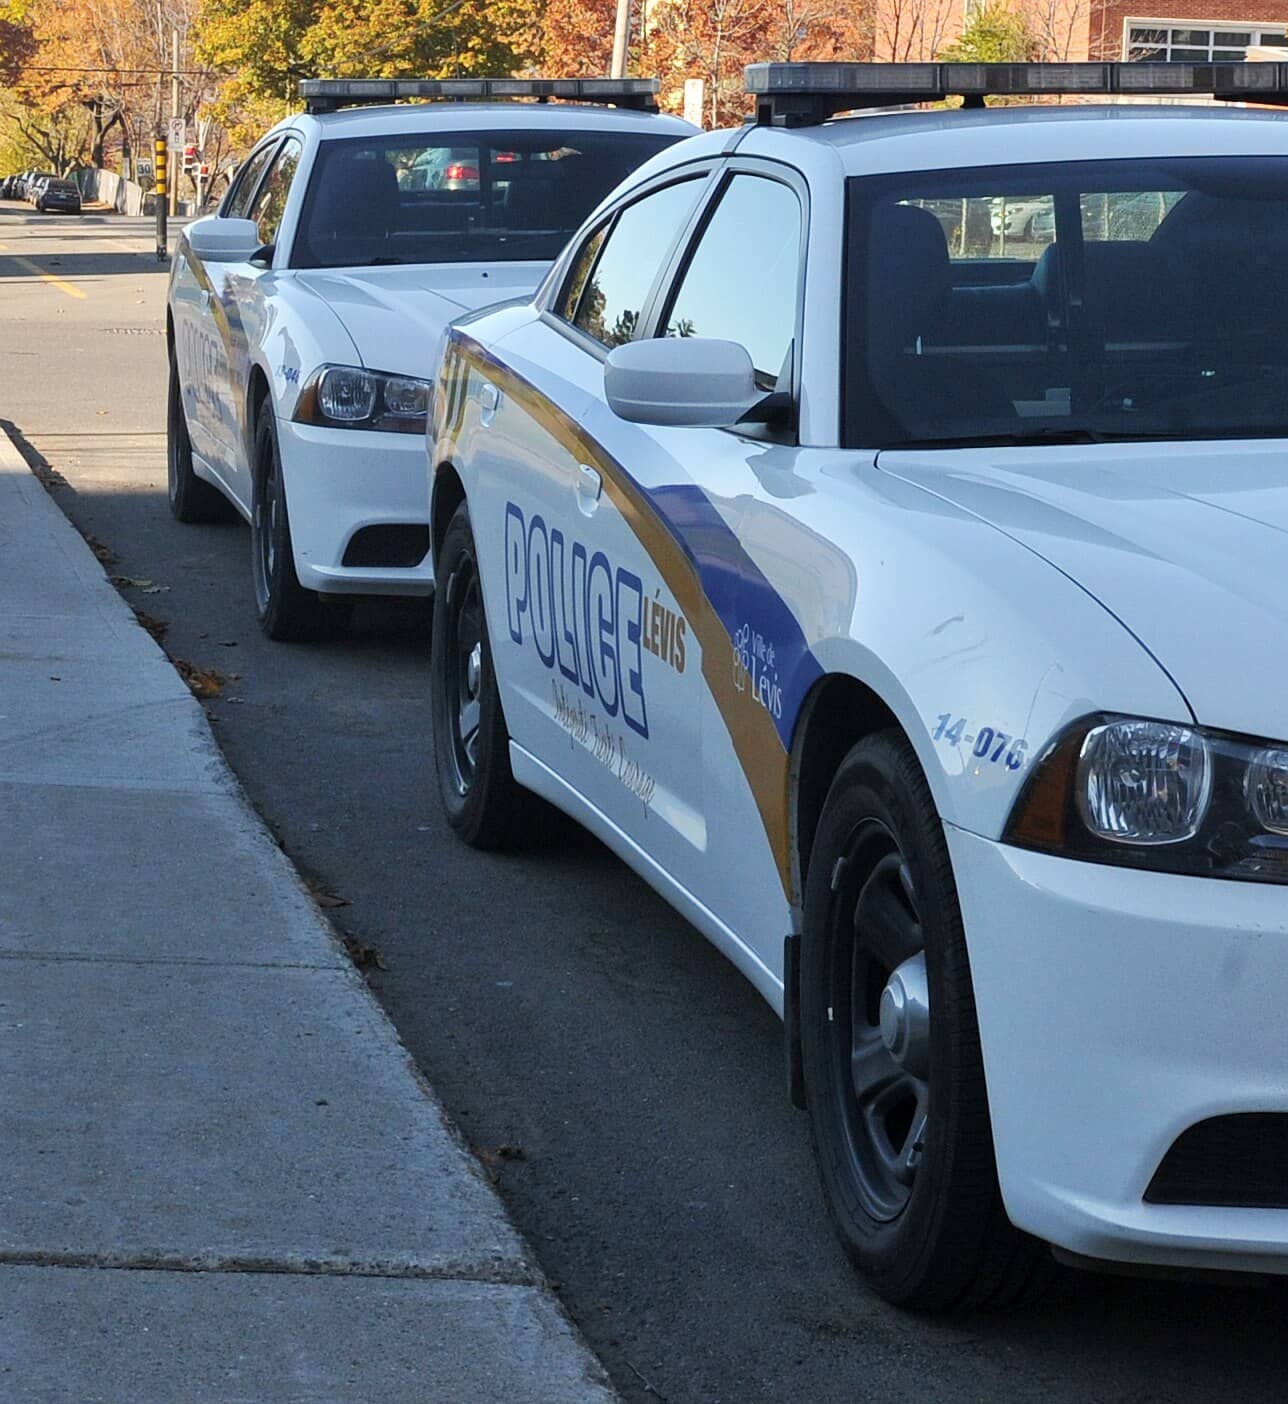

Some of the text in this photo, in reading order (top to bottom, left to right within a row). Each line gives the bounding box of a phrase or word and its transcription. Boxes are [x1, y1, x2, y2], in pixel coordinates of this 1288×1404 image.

[138, 164, 151, 175] 30
[505, 501, 649, 740] POLICE
[643, 588, 686, 674] LÉVIS
[751, 630, 766, 662] Ville
[751, 655, 782, 719] Lévis
[931, 712, 1030, 770] 14-076
